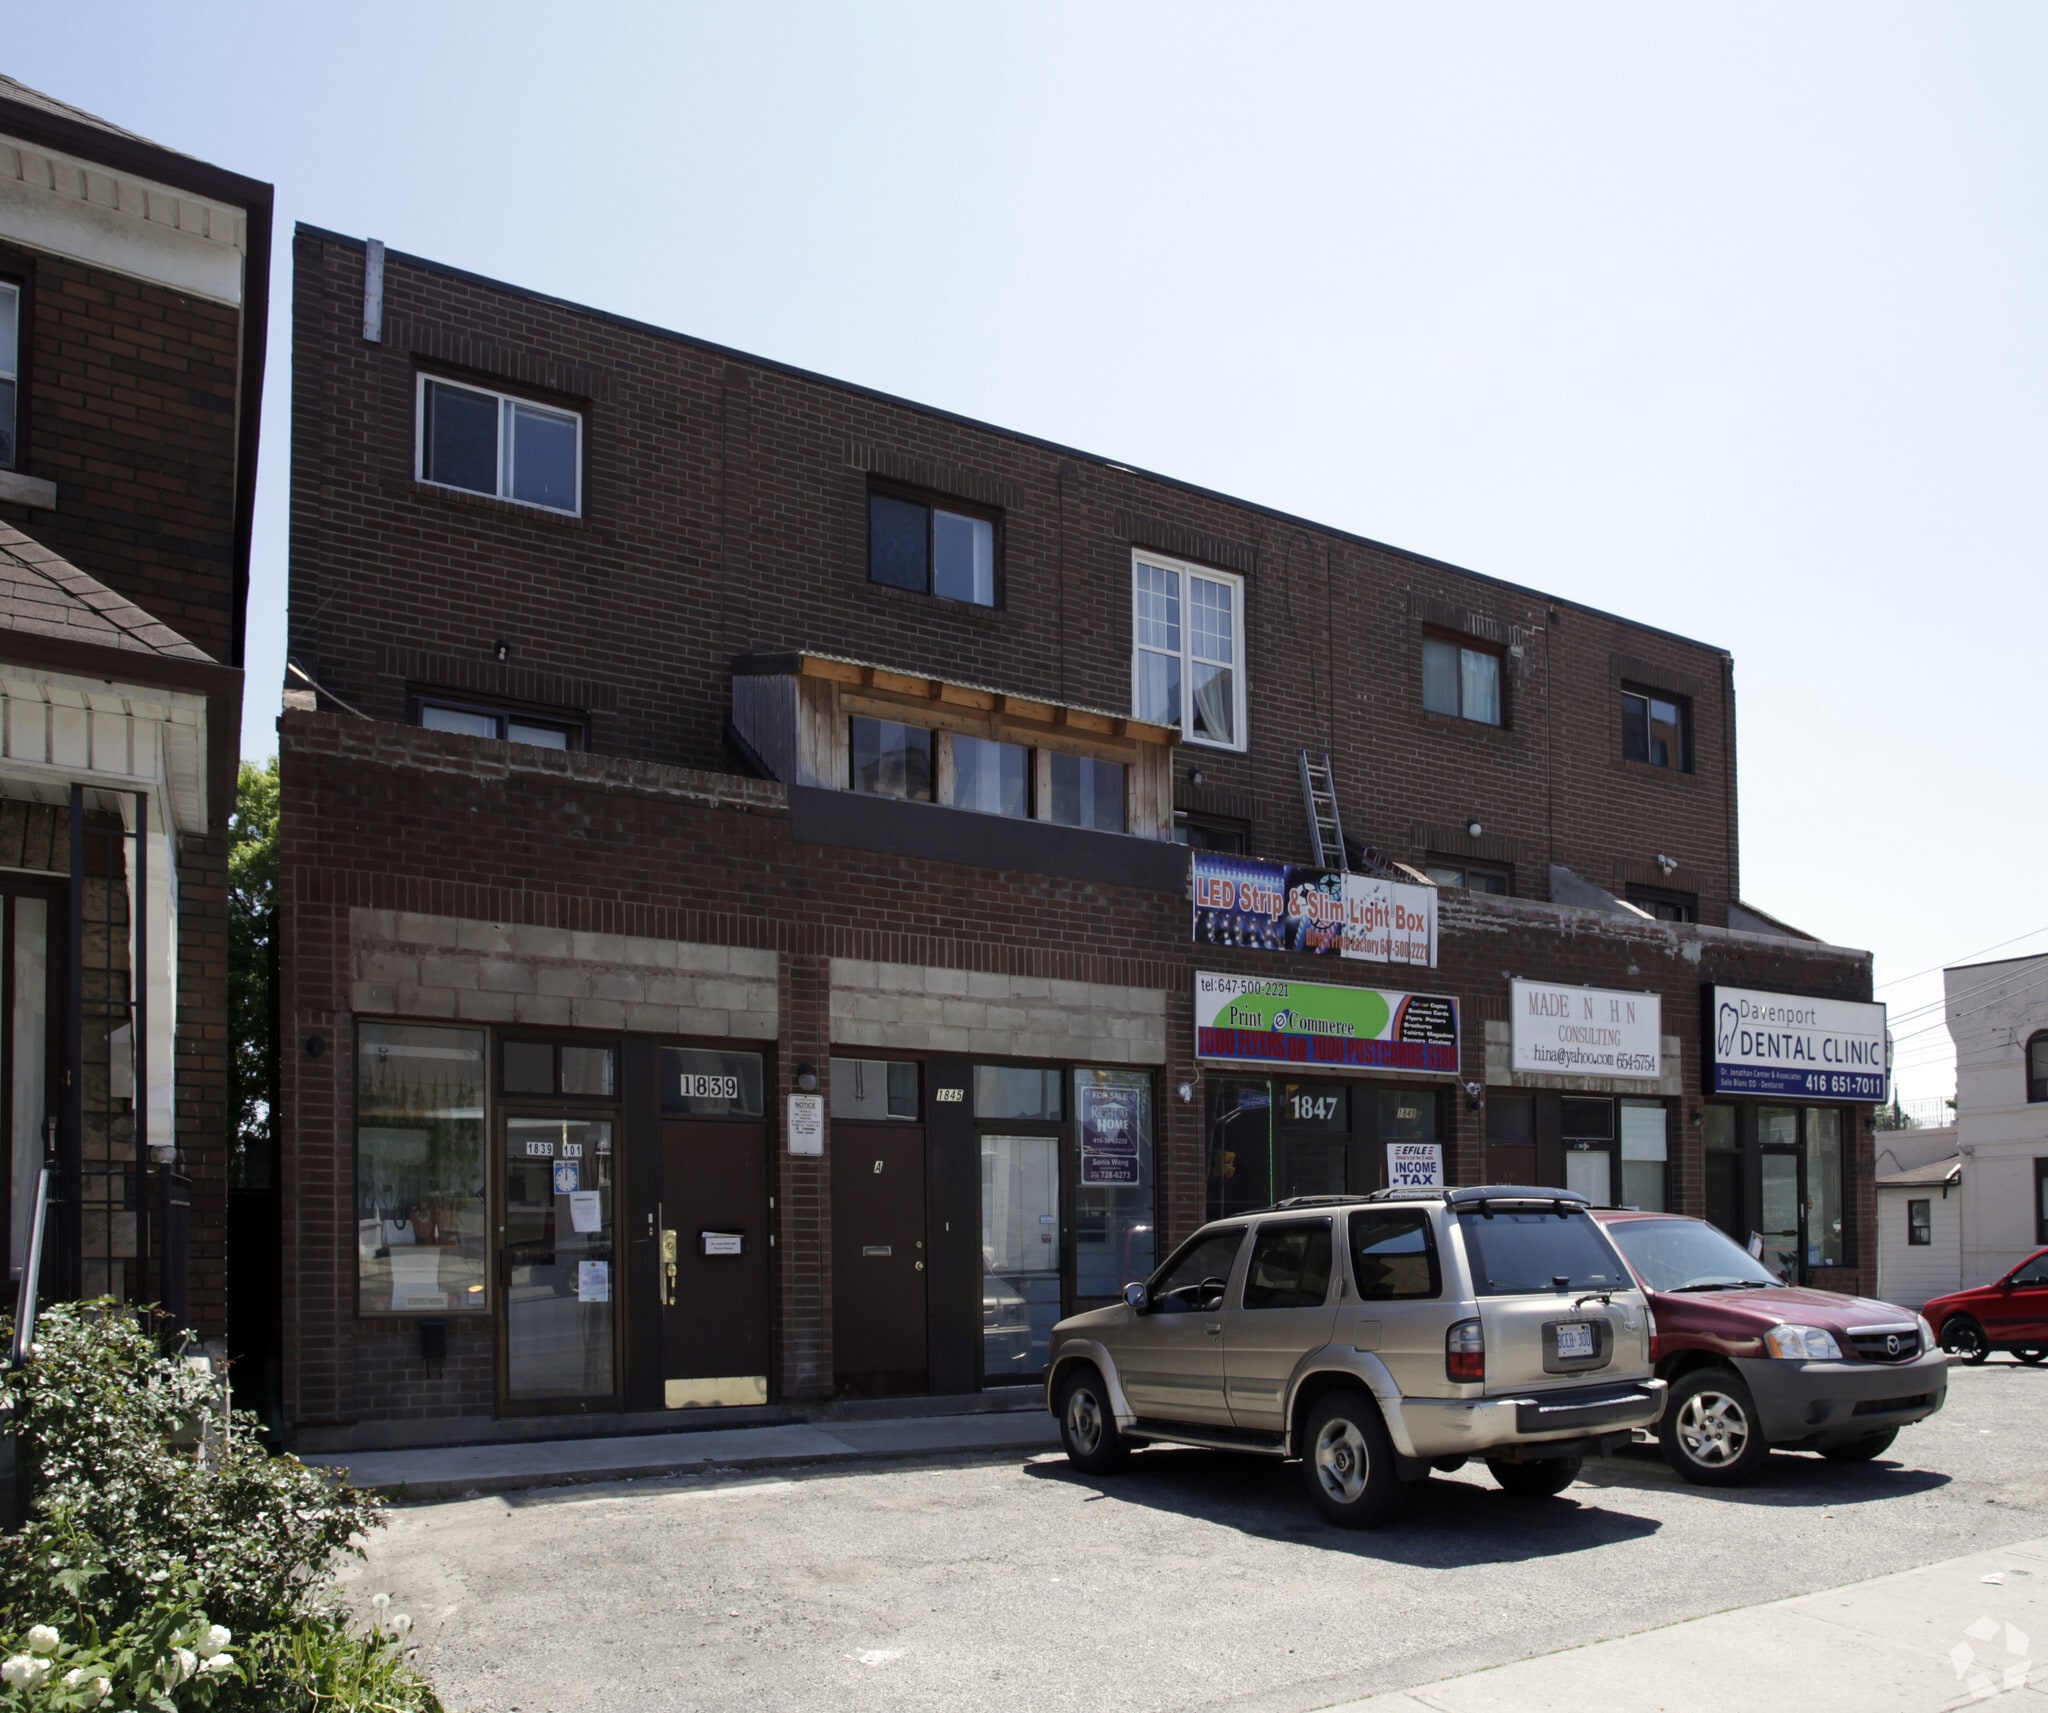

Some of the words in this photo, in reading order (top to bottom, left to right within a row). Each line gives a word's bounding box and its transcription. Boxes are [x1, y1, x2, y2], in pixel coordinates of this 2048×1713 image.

[1197, 876, 1235, 909] LED
[1239, 882, 1284, 921] Strip
[1288, 887, 1301, 916] &
[1307, 890, 1345, 922] Slim
[1350, 898, 1390, 932] Light
[1395, 904, 1425, 932] Box
[1529, 991, 1569, 1017] MADE
[1230, 1005, 1263, 1027] Print
[1740, 999, 1816, 1028] Davenport
[1558, 1025, 1621, 1047] CONSULTING
[1198, 1027, 1235, 1055] 1000
[1238, 1030, 1285, 1059] FLYERS
[1288, 1037, 1307, 1062] OR
[1312, 1035, 1344, 1062] 1000
[1348, 1038, 1424, 1068] POSTCARDS
[1740, 1031, 1816, 1061] DENTAL
[1823, 1038, 1880, 1066] CLINIC
[1729, 1068, 1753, 1077] Jonathan
[1776, 1071, 1802, 1080] Associates
[683, 1076, 736, 1096] 1839
[1805, 1074, 1827, 1092] 416
[1831, 1076, 1880, 1094] 651-7011
[938, 1090, 963, 1100] 1845
[1092, 1091, 1108, 1099] FOR
[1109, 1092, 1128, 1100] SALE
[1290, 1096, 1338, 1119] 1847
[1097, 1119, 1129, 1132] HOME
[528, 1143, 552, 1155] 1839
[564, 1145, 581, 1156] 101
[1403, 1146, 1427, 1154] EFILE
[875, 1162, 881, 1172] A
[1395, 1162, 1437, 1173] INCOME
[1400, 1174, 1433, 1185] TAX
